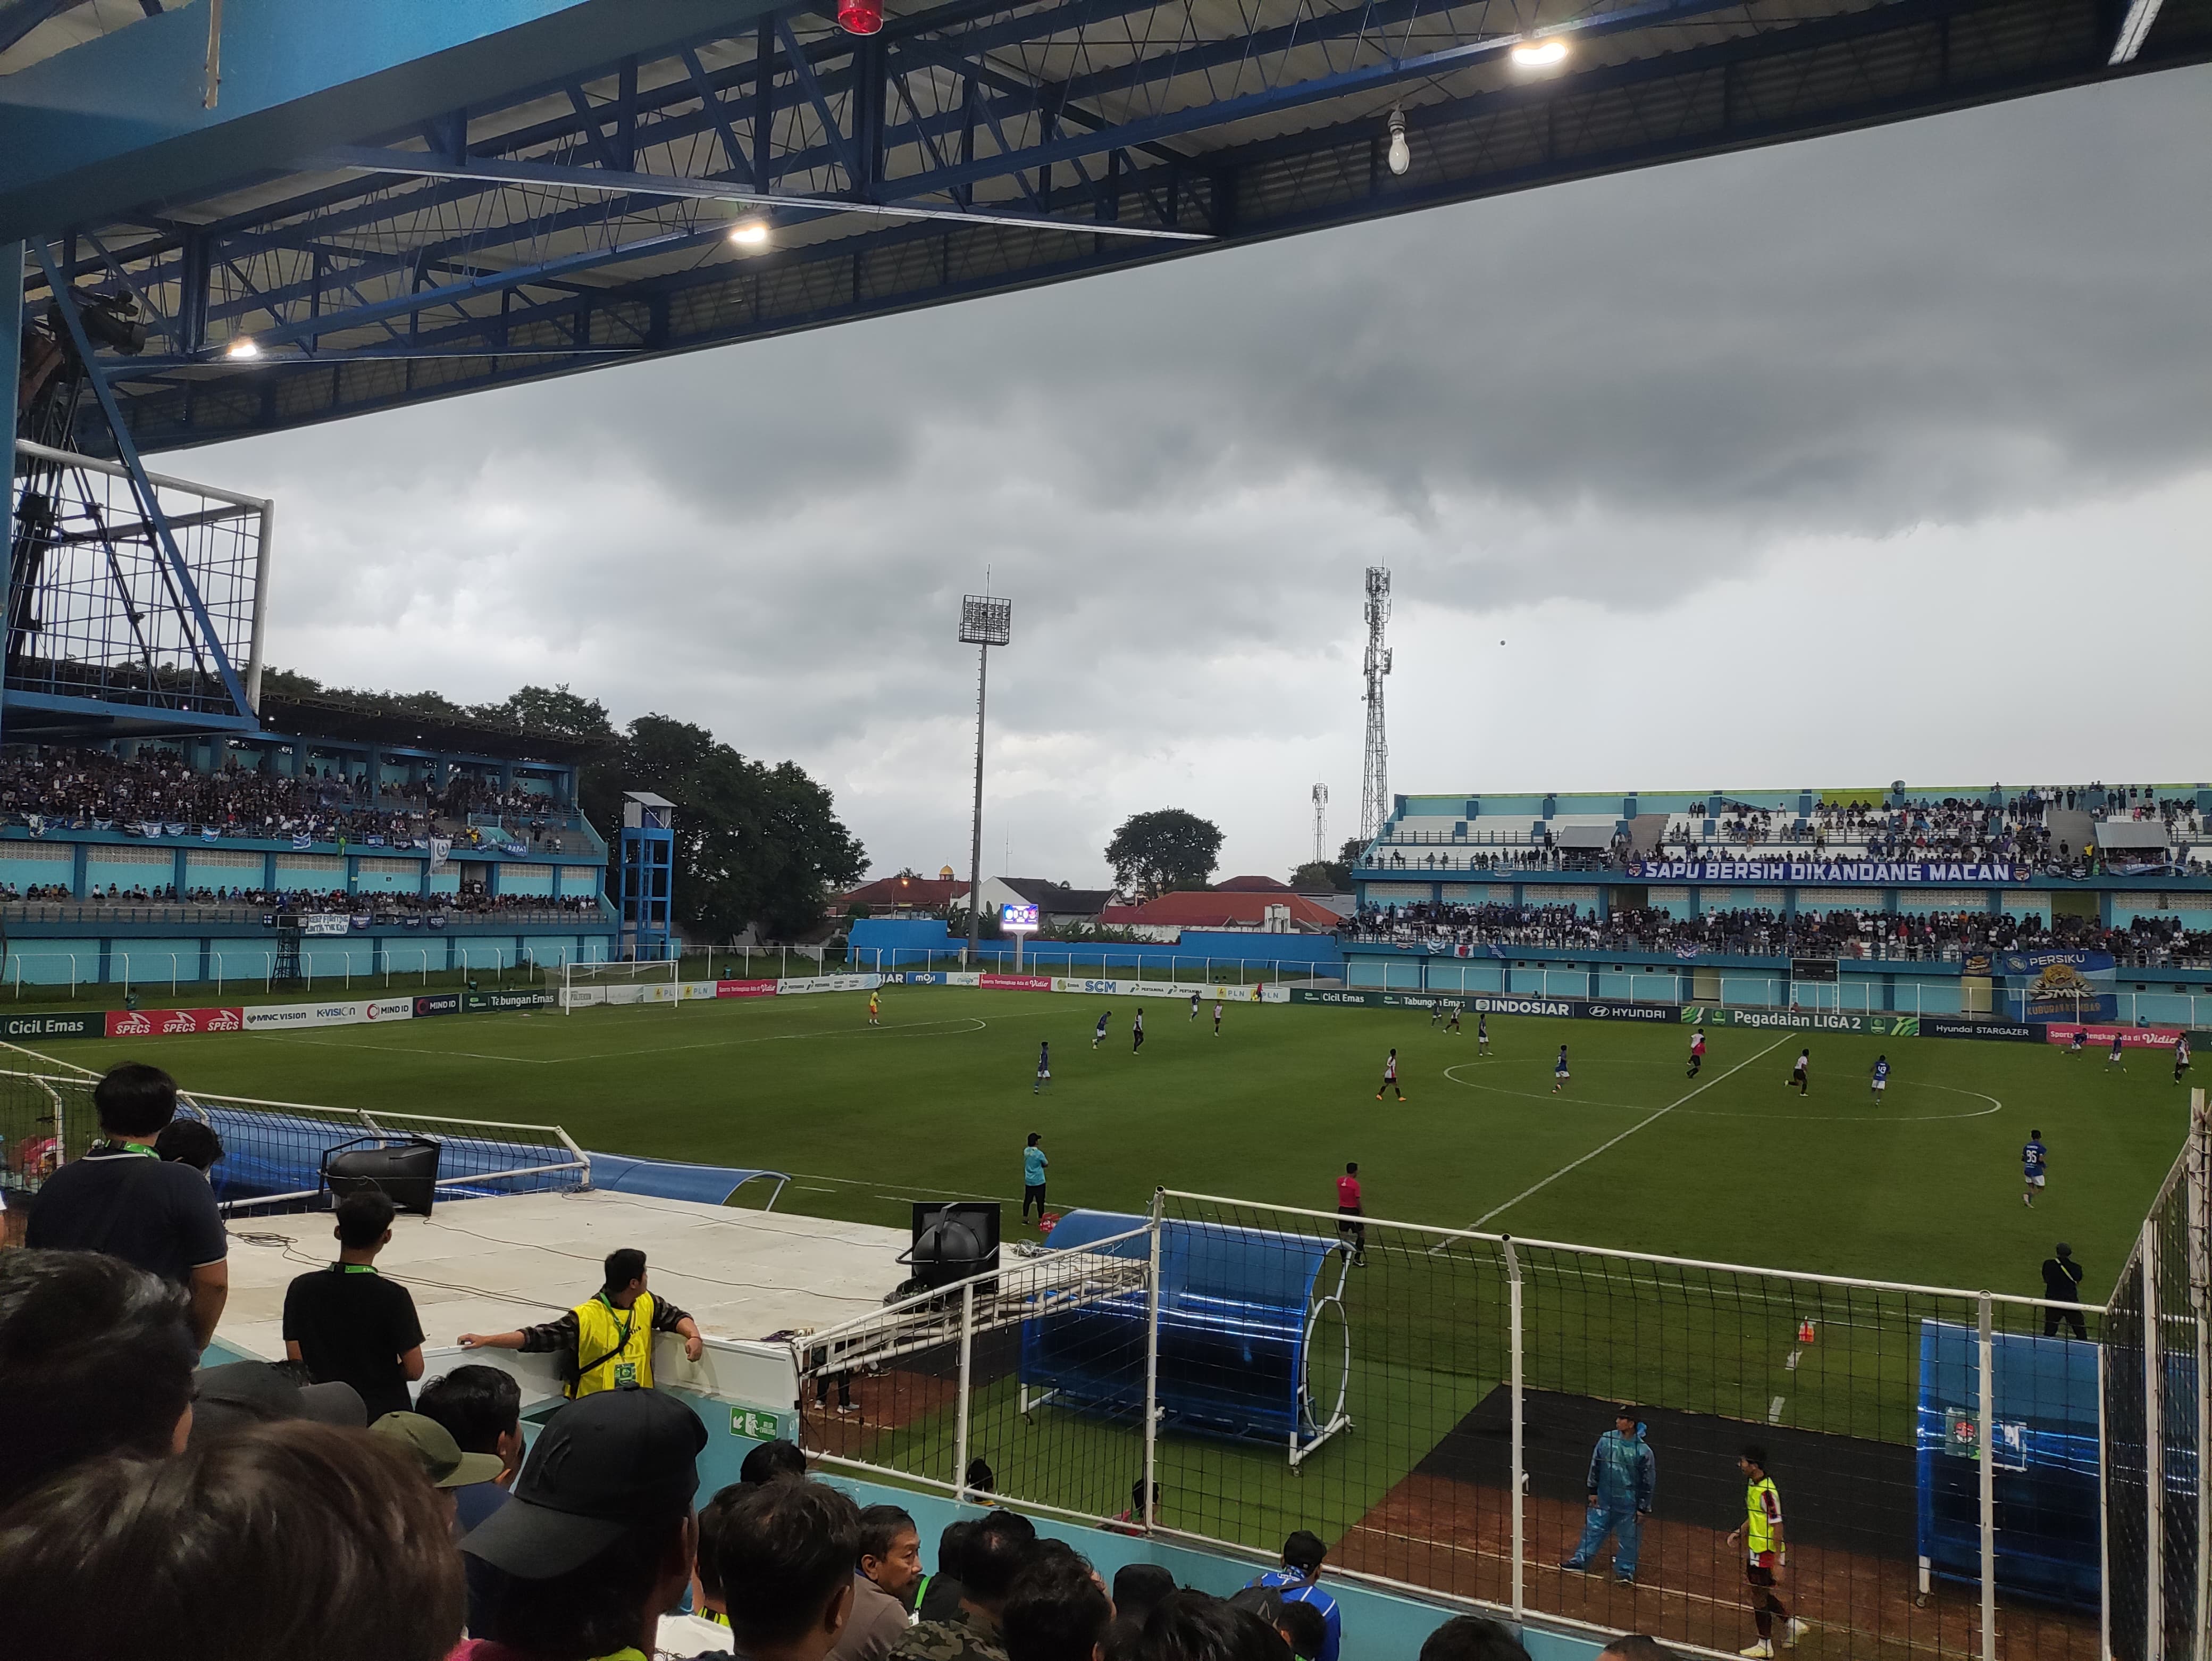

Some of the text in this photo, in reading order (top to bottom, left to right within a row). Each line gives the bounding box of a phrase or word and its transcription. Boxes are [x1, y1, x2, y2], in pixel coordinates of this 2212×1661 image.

[1645, 862, 2009, 881] SAPU BERSIH DIKANDANG MACAN
[2029, 954, 2085, 966] PERSIKU
[1085, 981, 1116, 992] SCM
[532, 994, 554, 1004] Emas
[1323, 993, 1340, 1001] Cicil
[1342, 994, 1364, 1003] Emas
[381, 1005, 399, 1014] MIND
[430, 1001, 448, 1009] MIND
[1492, 1000, 1569, 1015] INDOSIAR
[1612, 1007, 1666, 1019] HYUNDAI
[207, 1021, 239, 1031] SPECS
[1735, 1011, 1861, 1030] Pegadaian LIGA 2
[9, 1020, 84, 1034] Cicil Emas
[115, 1024, 150, 1034] SPECS
[163, 1023, 196, 1033] SPECS
[1936, 1025, 2029, 1036] Hyundai STARGAZER
[2142, 1033, 2179, 1044] Vidio
